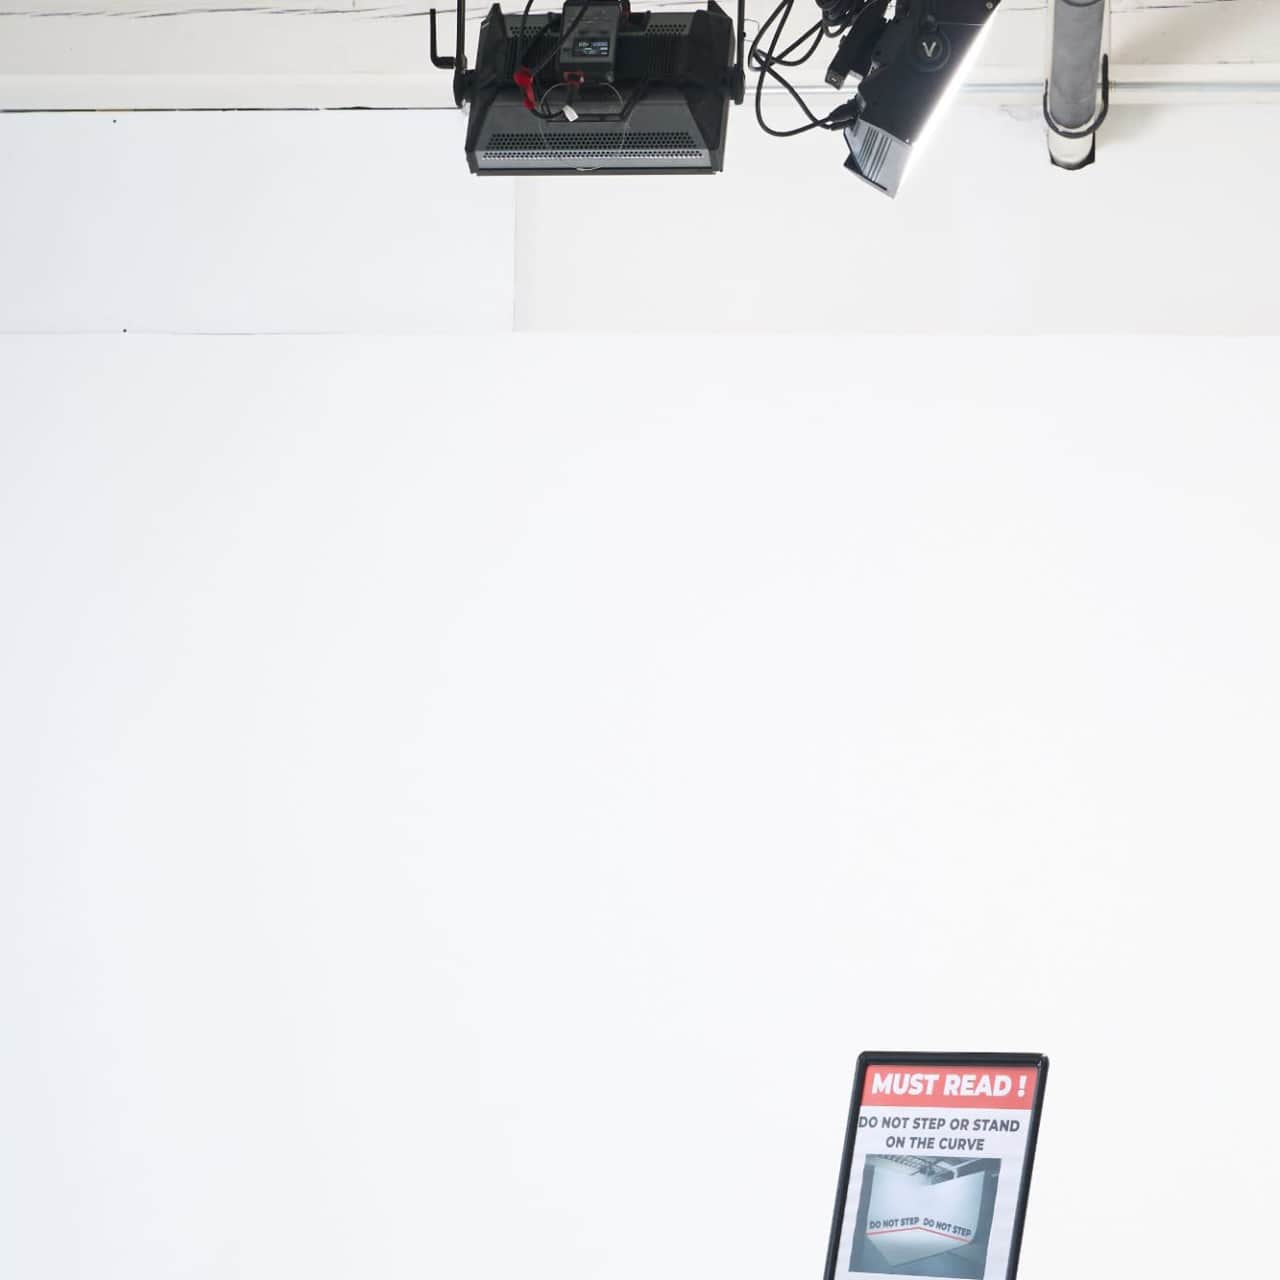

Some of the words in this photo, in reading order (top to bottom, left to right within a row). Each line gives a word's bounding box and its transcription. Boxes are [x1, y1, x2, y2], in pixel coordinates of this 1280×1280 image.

[872, 1072, 941, 1096] MUST
[943, 1073, 1012, 1097] READ
[1017, 1075, 1027, 1097] !
[858, 1116, 878, 1128] DO
[881, 1116, 910, 1129] NOT
[912, 1117, 946, 1130] STEP
[949, 1118, 969, 1131] OR
[972, 1118, 1020, 1132] STAND
[885, 1136, 906, 1148] ON
[909, 1136, 936, 1149] THE
[938, 1138, 985, 1151] CURVE
[869, 1220, 881, 1229] DO
[882, 1218, 899, 1227] NOT
[900, 1216, 920, 1226] STEP
[923, 1217, 935, 1227] DO
[935, 1221, 952, 1232] NOT
[952, 1225, 972, 1236] STEP
